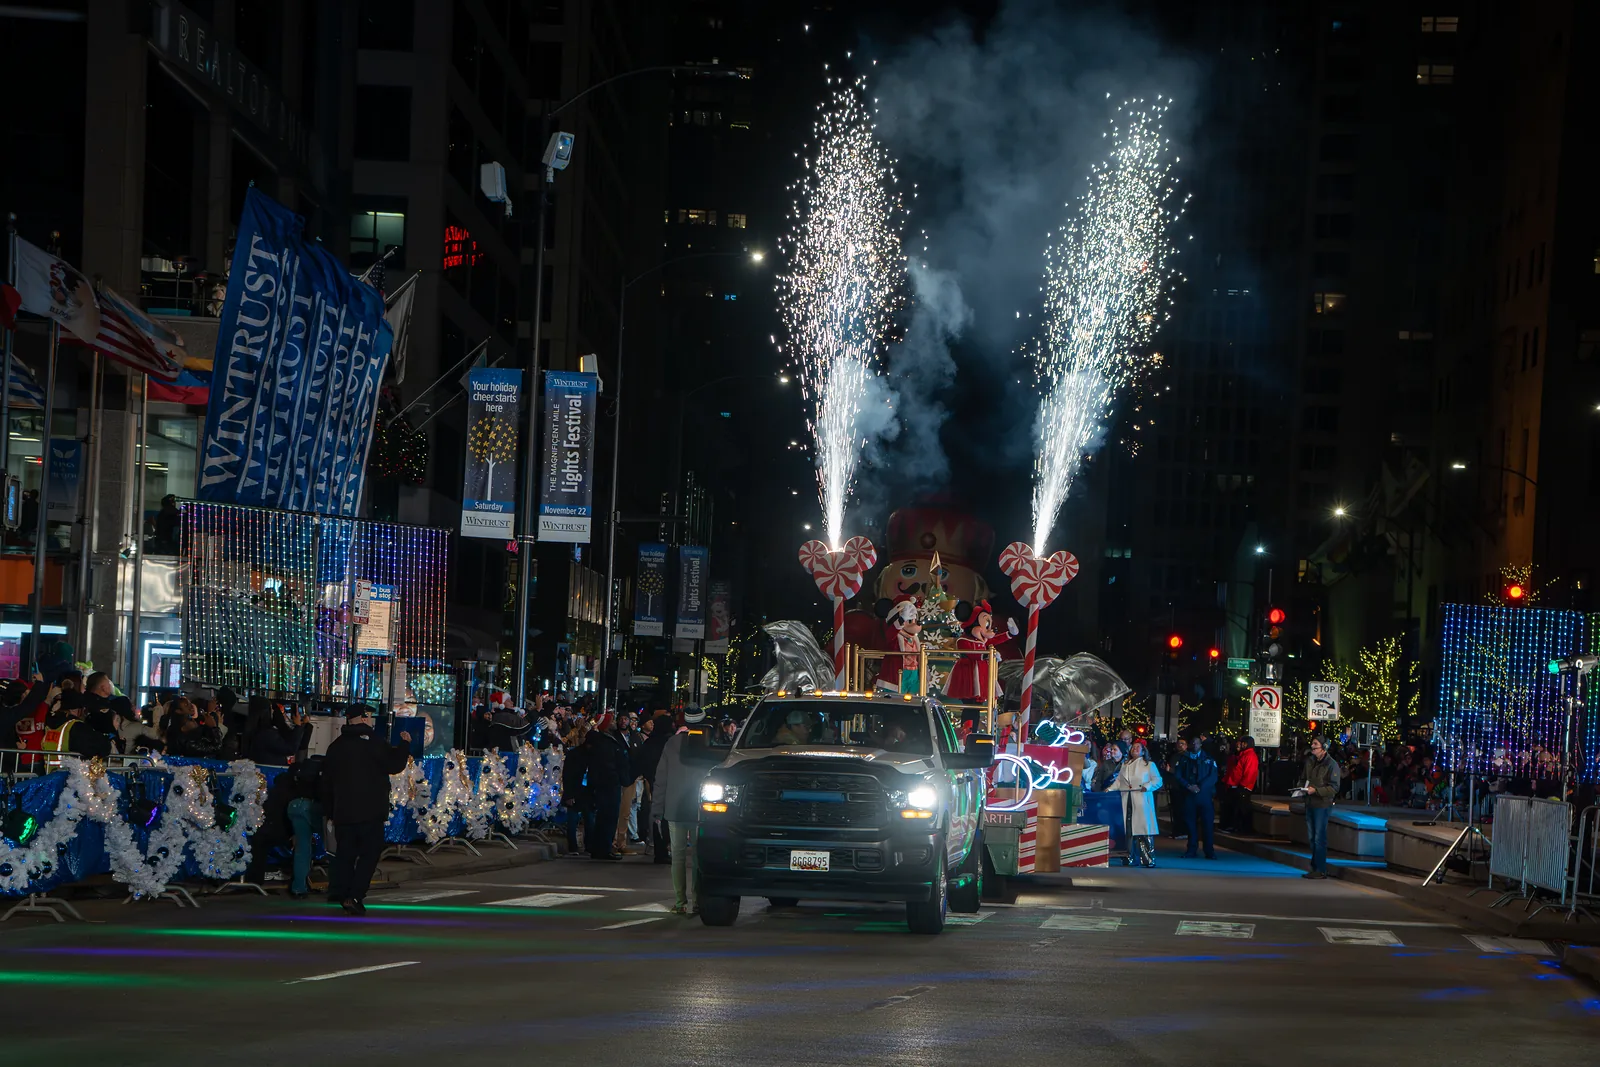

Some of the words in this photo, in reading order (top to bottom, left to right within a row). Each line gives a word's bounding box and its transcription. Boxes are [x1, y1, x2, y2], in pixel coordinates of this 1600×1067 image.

[200, 233, 280, 489] WINTRUST
[472, 381, 489, 391] Your
[490, 382, 518, 395] holiday
[553, 378, 588, 387] WINTRUST
[472, 392, 494, 402] cheer
[495, 393, 517, 403] starts
[485, 403, 503, 412] here
[563, 394, 582, 448] Festival
[550, 424, 560, 473] MAGNIFICENT
[561, 452, 582, 493] Lights
[549, 476, 557, 492] THE
[474, 501, 504, 512] Saturday
[544, 506, 577, 515] November
[577, 507, 587, 515] 22
[465, 516, 511, 527] WINTRUST
[542, 521, 587, 531] WINTRUST
[689, 556, 700, 588] Festival
[688, 588, 701, 612] Lights
[1313, 685, 1336, 693] STOP
[1311, 709, 1328, 717] RED
